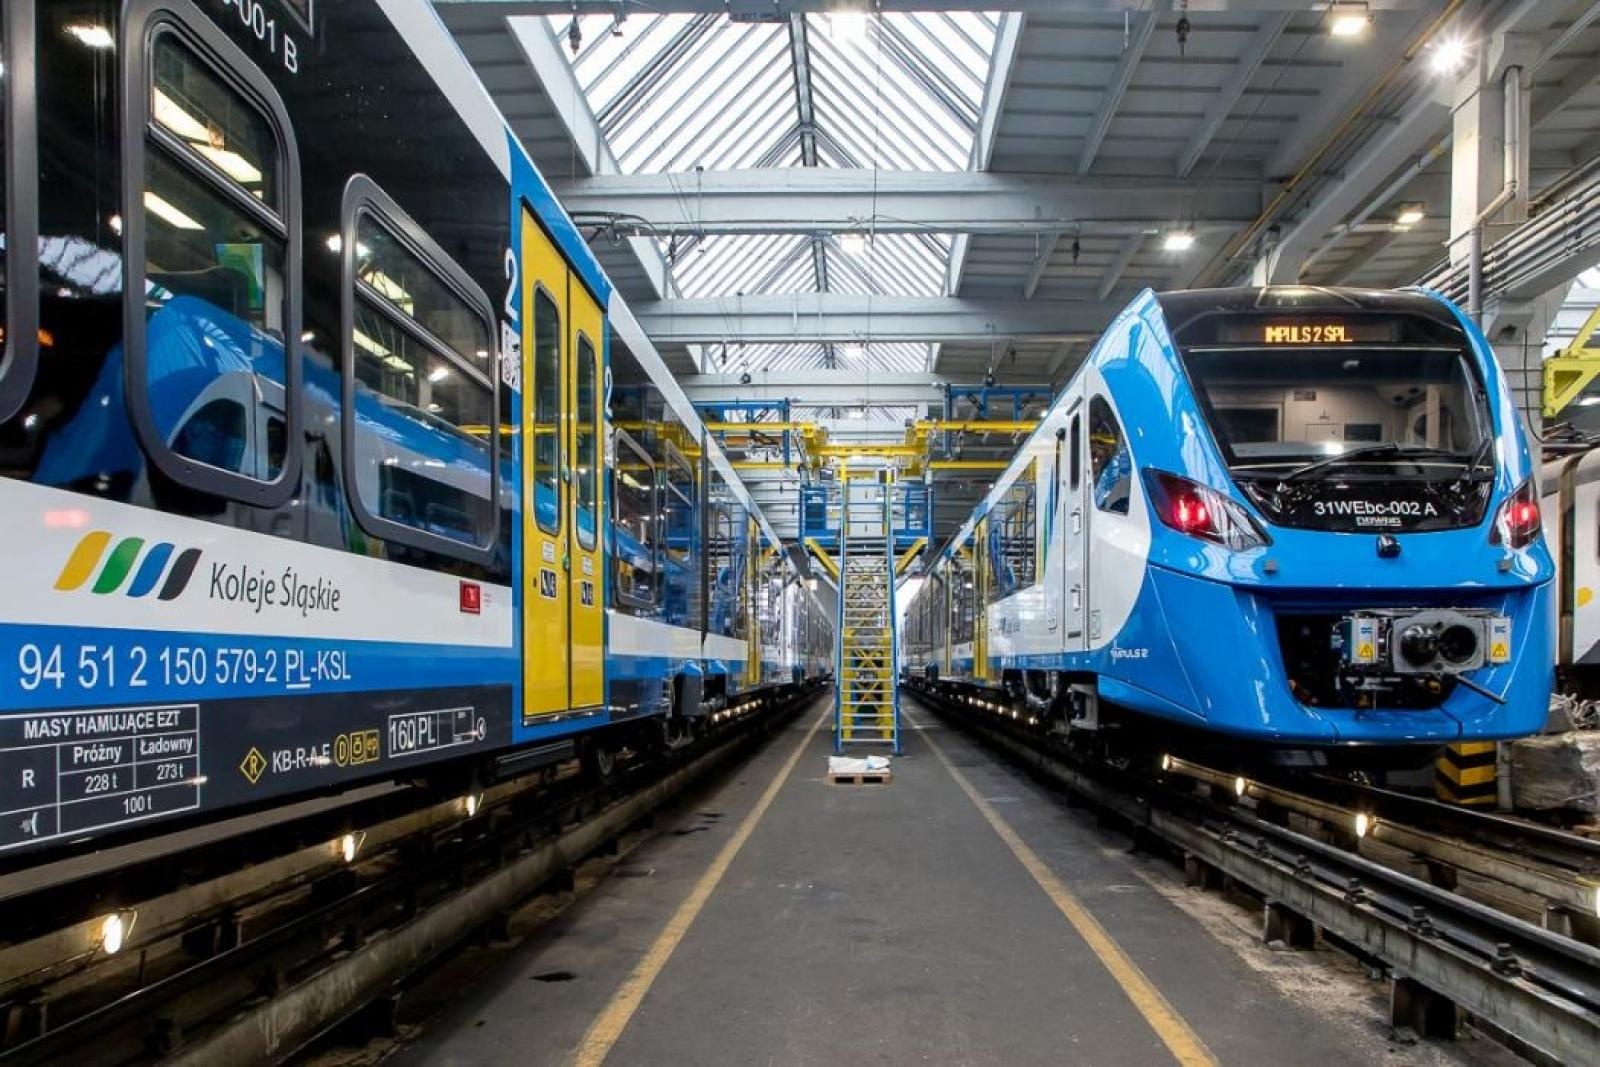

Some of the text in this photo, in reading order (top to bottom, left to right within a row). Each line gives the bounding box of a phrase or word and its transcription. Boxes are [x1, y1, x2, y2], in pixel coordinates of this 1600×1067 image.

[284, 33, 298, 73] B
[505, 248, 518, 321] 2
[1313, 325, 1322, 342] 2
[605, 366, 613, 418] 2
[1314, 501, 1438, 516] 31WEbc-002 A
[210, 562, 341, 617] Koleje Śląskie
[19, 644, 351, 690] 94 51 2 150 579-2 PL-KSL
[24, 710, 181, 739] MASY HAMUJĄCE EZT
[390, 716, 436, 751] 160 PL
[73, 744, 122, 763] Próżny
[140, 737, 193, 755] Ładowny
[157, 764, 184, 781] 273 t
[249, 755, 258, 773] R
[22, 769, 35, 788] R
[85, 773, 118, 794] 228 t
[123, 794, 153, 815] 100 t
